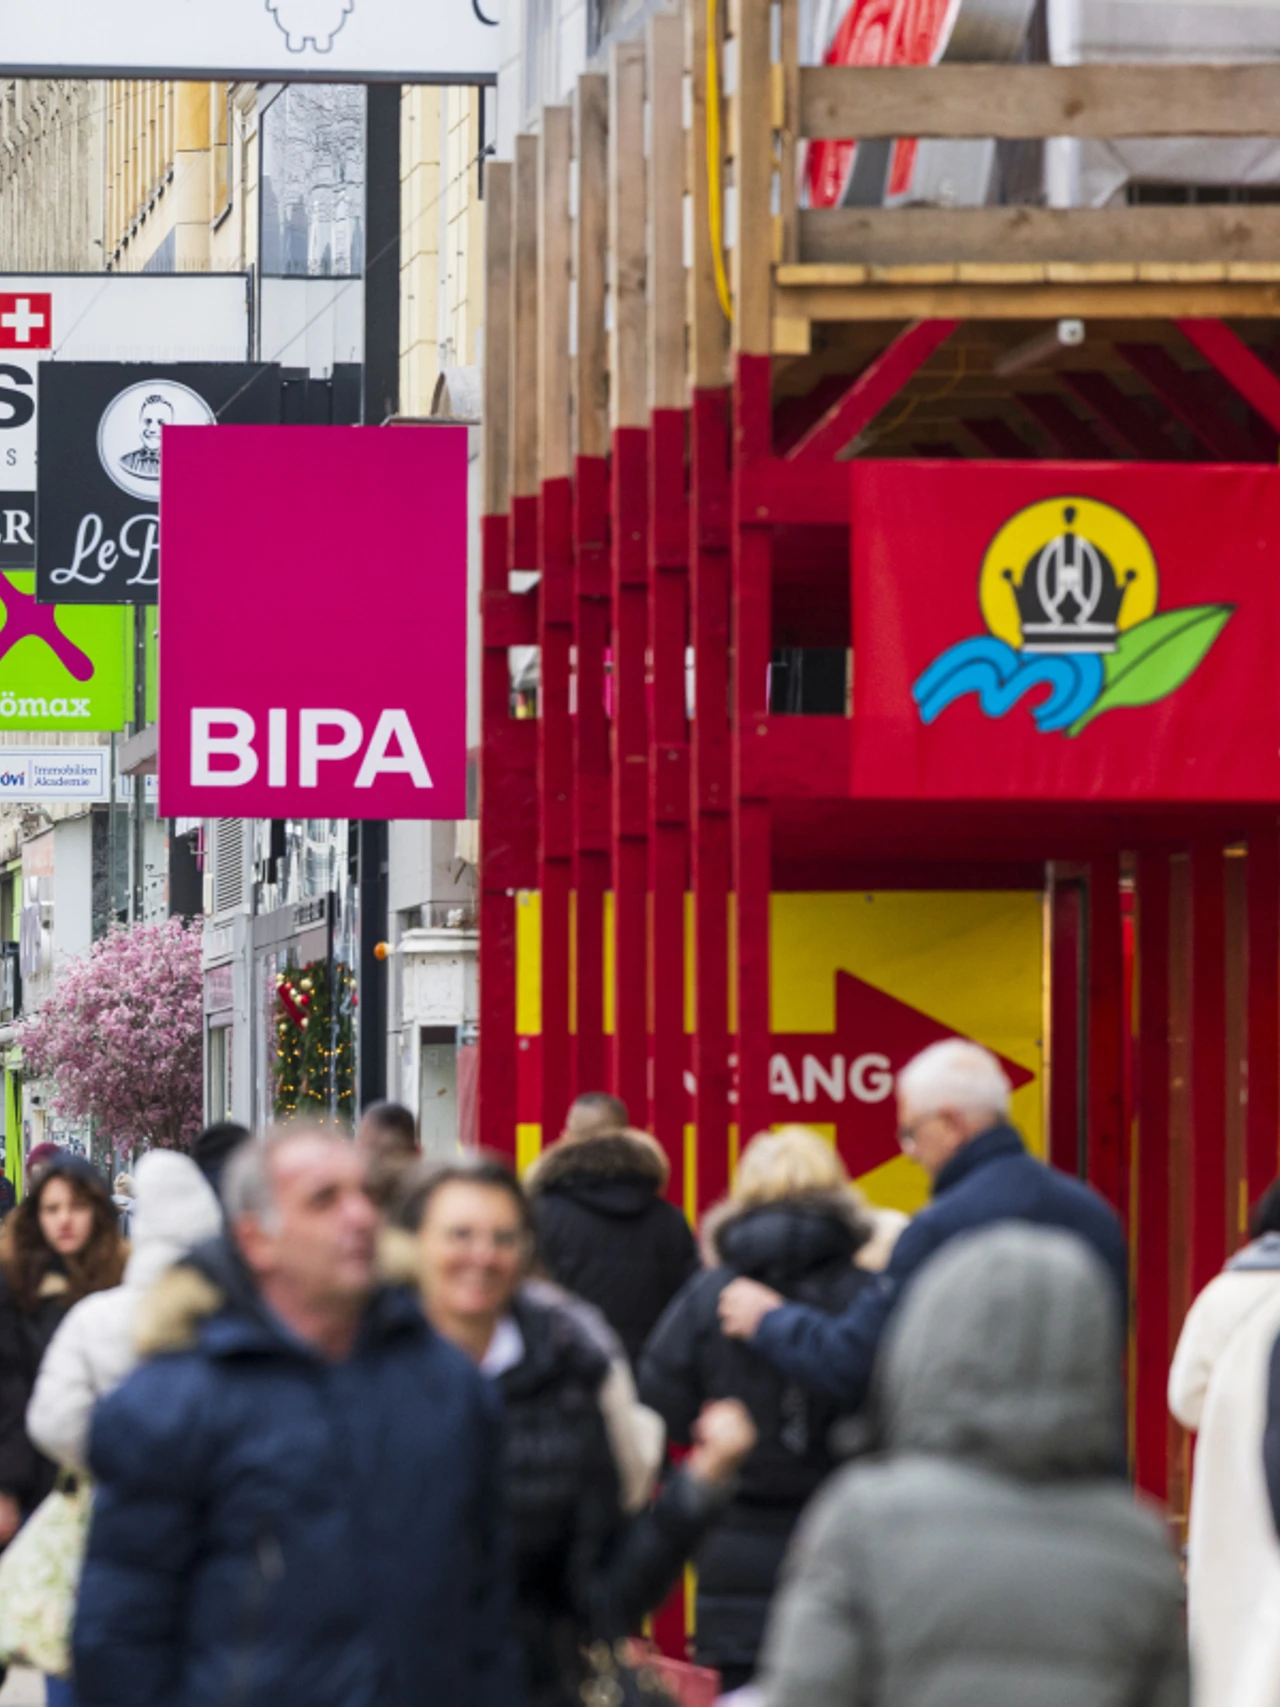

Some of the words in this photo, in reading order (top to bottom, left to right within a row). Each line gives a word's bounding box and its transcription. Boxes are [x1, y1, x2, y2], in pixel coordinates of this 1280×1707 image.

[50, 513, 119, 585] Le
[190, 707, 434, 788] BIPA
[34, 763, 97, 776] Immobilien
[34, 776, 91, 787] Akademie
